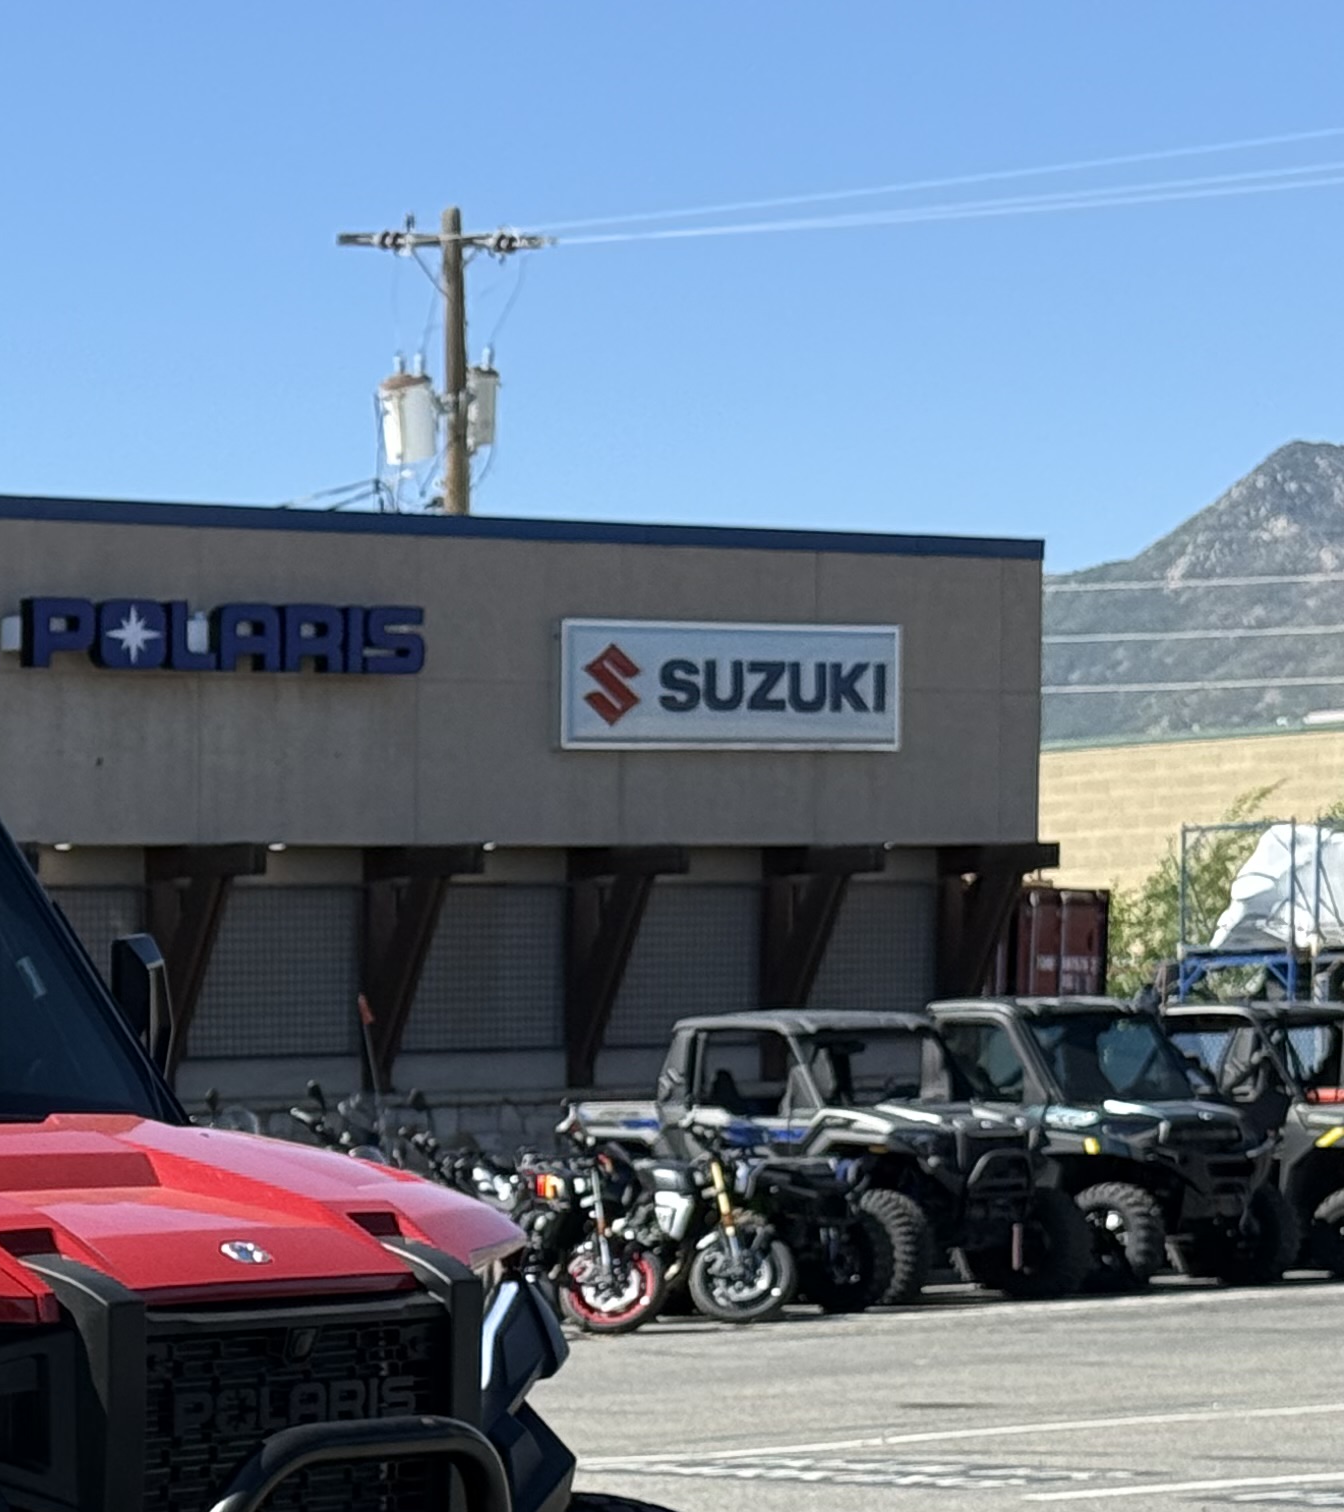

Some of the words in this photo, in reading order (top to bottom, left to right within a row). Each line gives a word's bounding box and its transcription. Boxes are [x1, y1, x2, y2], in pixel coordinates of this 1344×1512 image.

[21, 597, 425, 675] POLARIS
[658, 658, 887, 714] SUZUKI
[173, 1375, 416, 1438] POLARIS
